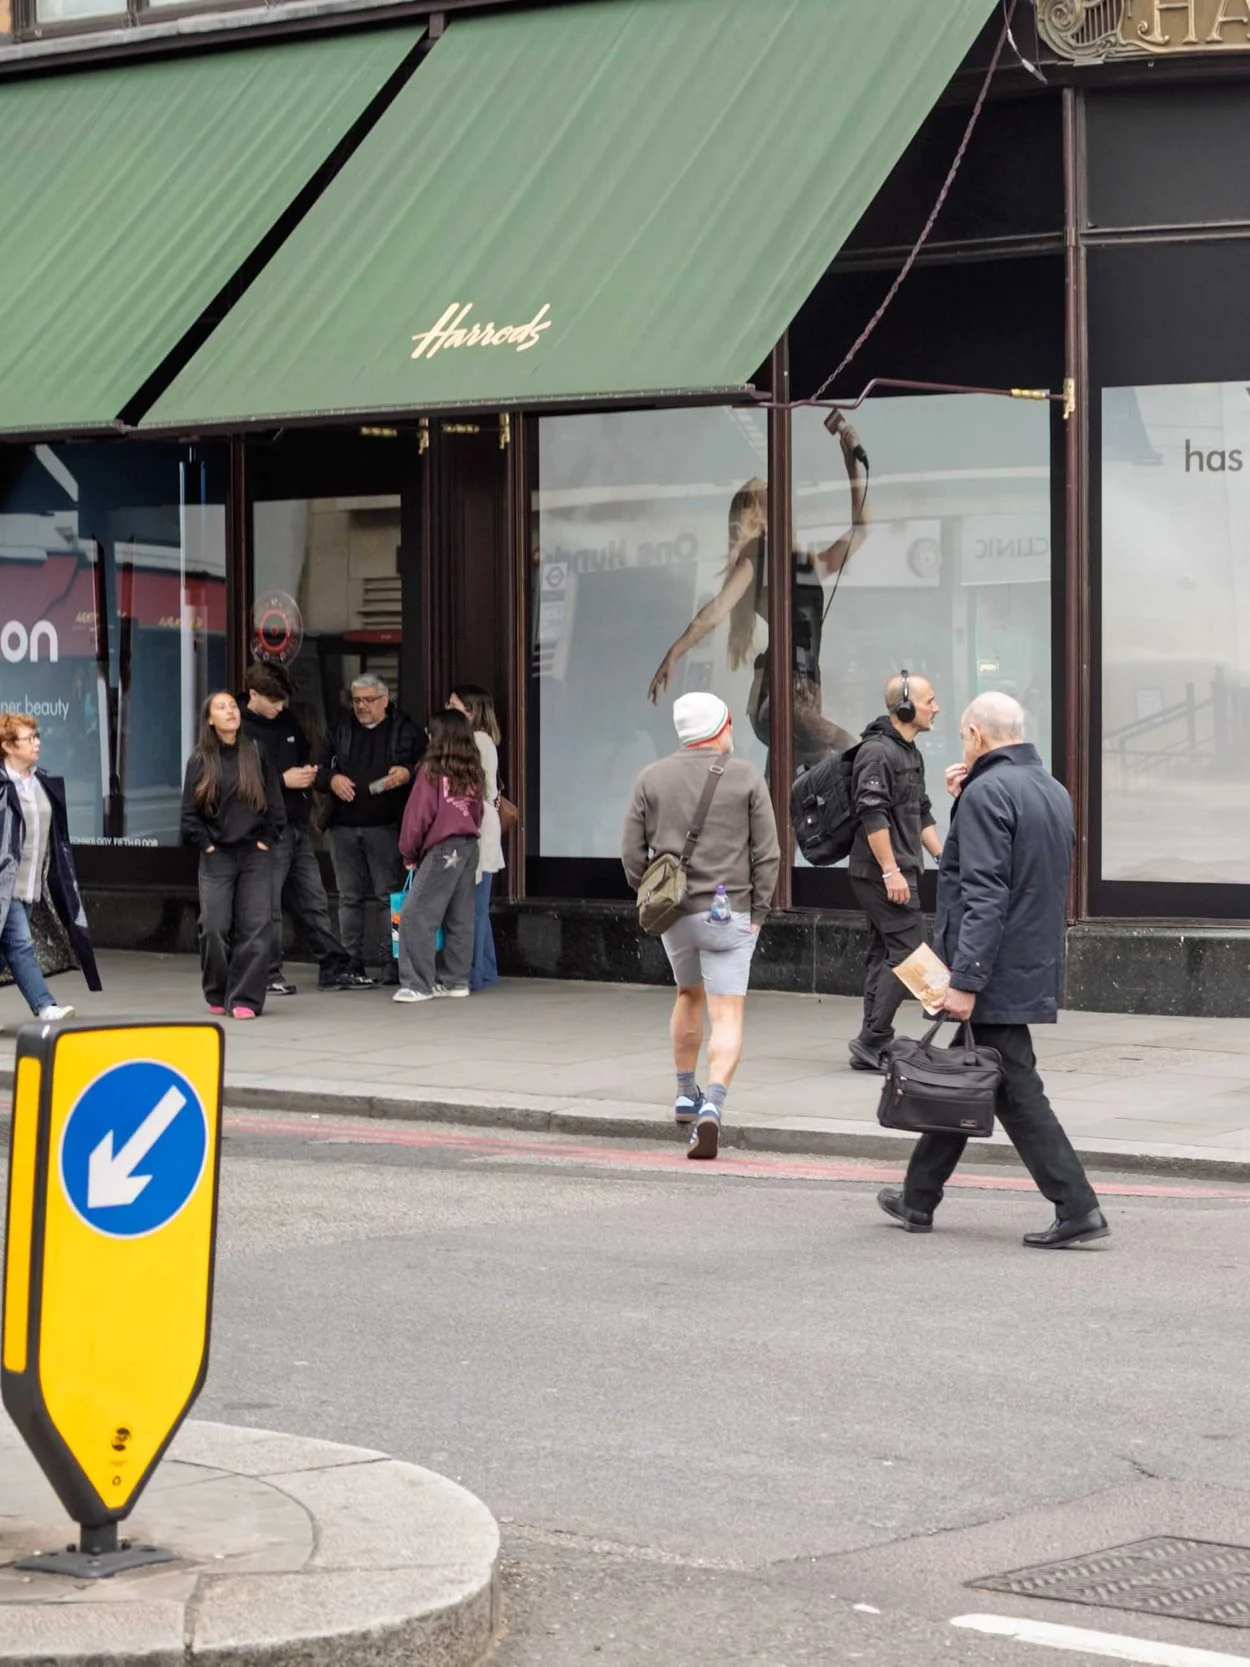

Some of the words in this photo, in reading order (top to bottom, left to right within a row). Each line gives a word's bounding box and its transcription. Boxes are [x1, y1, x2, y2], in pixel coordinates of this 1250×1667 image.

[411, 302, 552, 359] Harrods
[1185, 438, 1243, 472] has
[25, 694, 70, 722] beauty
